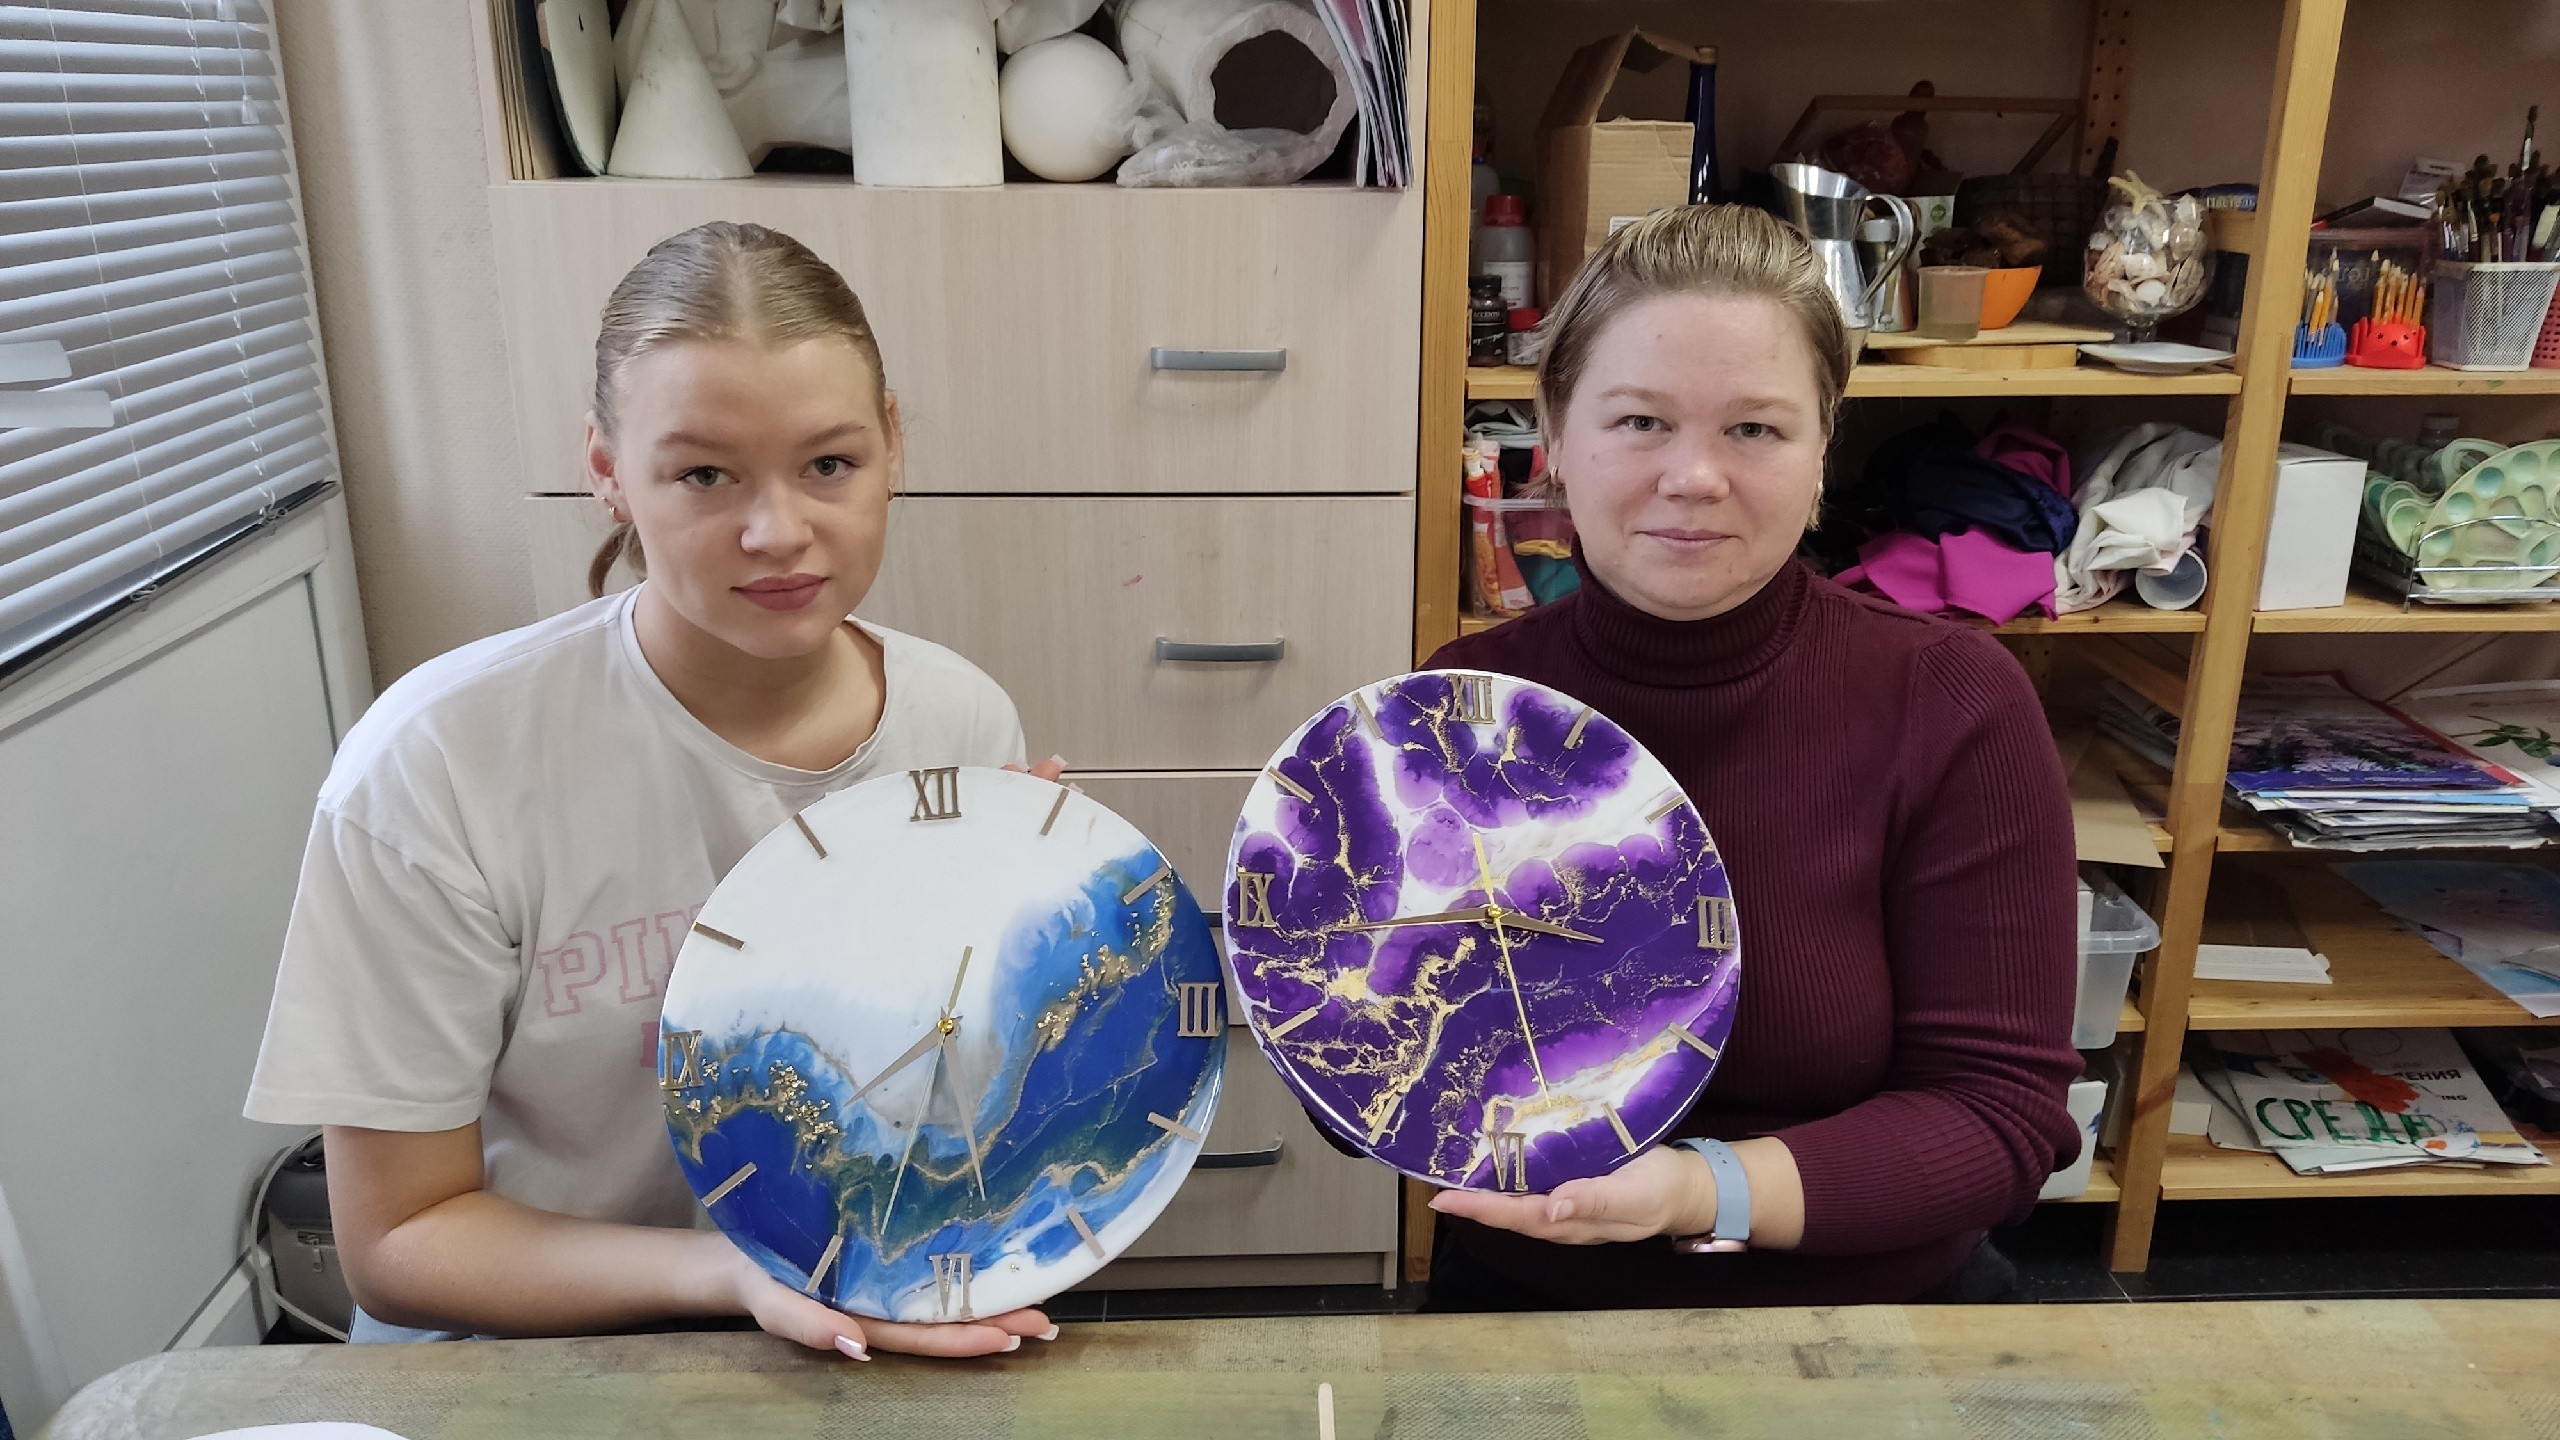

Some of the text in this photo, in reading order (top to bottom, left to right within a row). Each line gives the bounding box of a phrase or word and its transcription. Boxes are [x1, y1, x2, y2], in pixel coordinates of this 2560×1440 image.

[1446, 673, 1496, 724] XII
[909, 767, 962, 822] XII
[1237, 872, 1277, 927] IX
[1697, 895, 1734, 950] III
[1177, 982, 1220, 1037] III
[659, 1030, 704, 1091] IX
[1487, 1131, 1528, 1191] VI
[929, 1252, 973, 1319] VI
